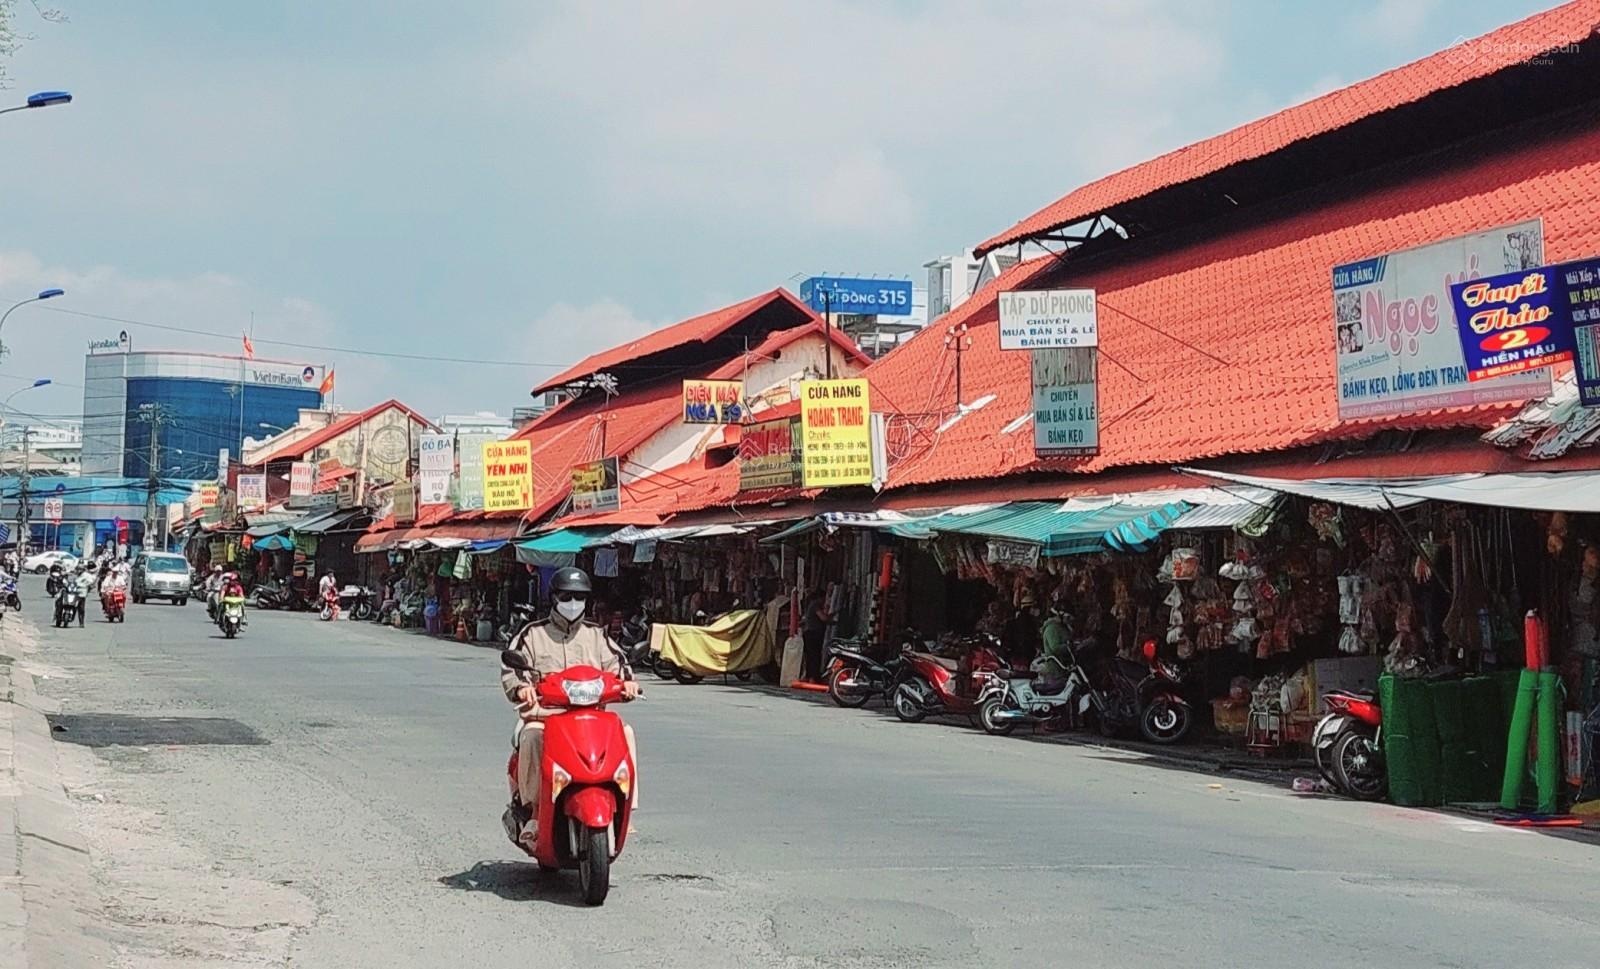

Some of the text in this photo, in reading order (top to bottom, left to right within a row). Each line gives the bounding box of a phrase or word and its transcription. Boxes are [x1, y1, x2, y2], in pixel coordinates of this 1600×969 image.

[1334, 265, 1373, 287] CỬA HÀNG
[841, 291, 876, 304] ĐỒNG
[878, 290, 907, 305] 315
[1462, 273, 1547, 307] Tuyết
[1027, 317, 1070, 326] CHUYÊN
[1365, 288, 1439, 356] Ngọc
[1470, 303, 1553, 333] Thảo
[1002, 328, 1026, 336] MUA
[1029, 327, 1052, 336] BÁN
[1499, 330, 1529, 349] 2
[1021, 337, 1050, 346] BÁNH
[1523, 344, 1556, 358] HẬU
[808, 382, 861, 399] CỬA HÀNG
[1343, 376, 1366, 398] BÁNH
[1393, 366, 1416, 391] LỒNG
[1418, 366, 1438, 388] ĐÈN
[1440, 365, 1468, 385] TRAN
[1050, 387, 1079, 403] CHUYÊN
[807, 403, 864, 427] HOÀNG TRANG
[1036, 410, 1051, 423] MUA
[1053, 406, 1067, 422] BÁN
[1085, 401, 1095, 420] LẺ
[1048, 427, 1084, 446] BÁNH KẸO
[487, 444, 503, 458] CỬA
